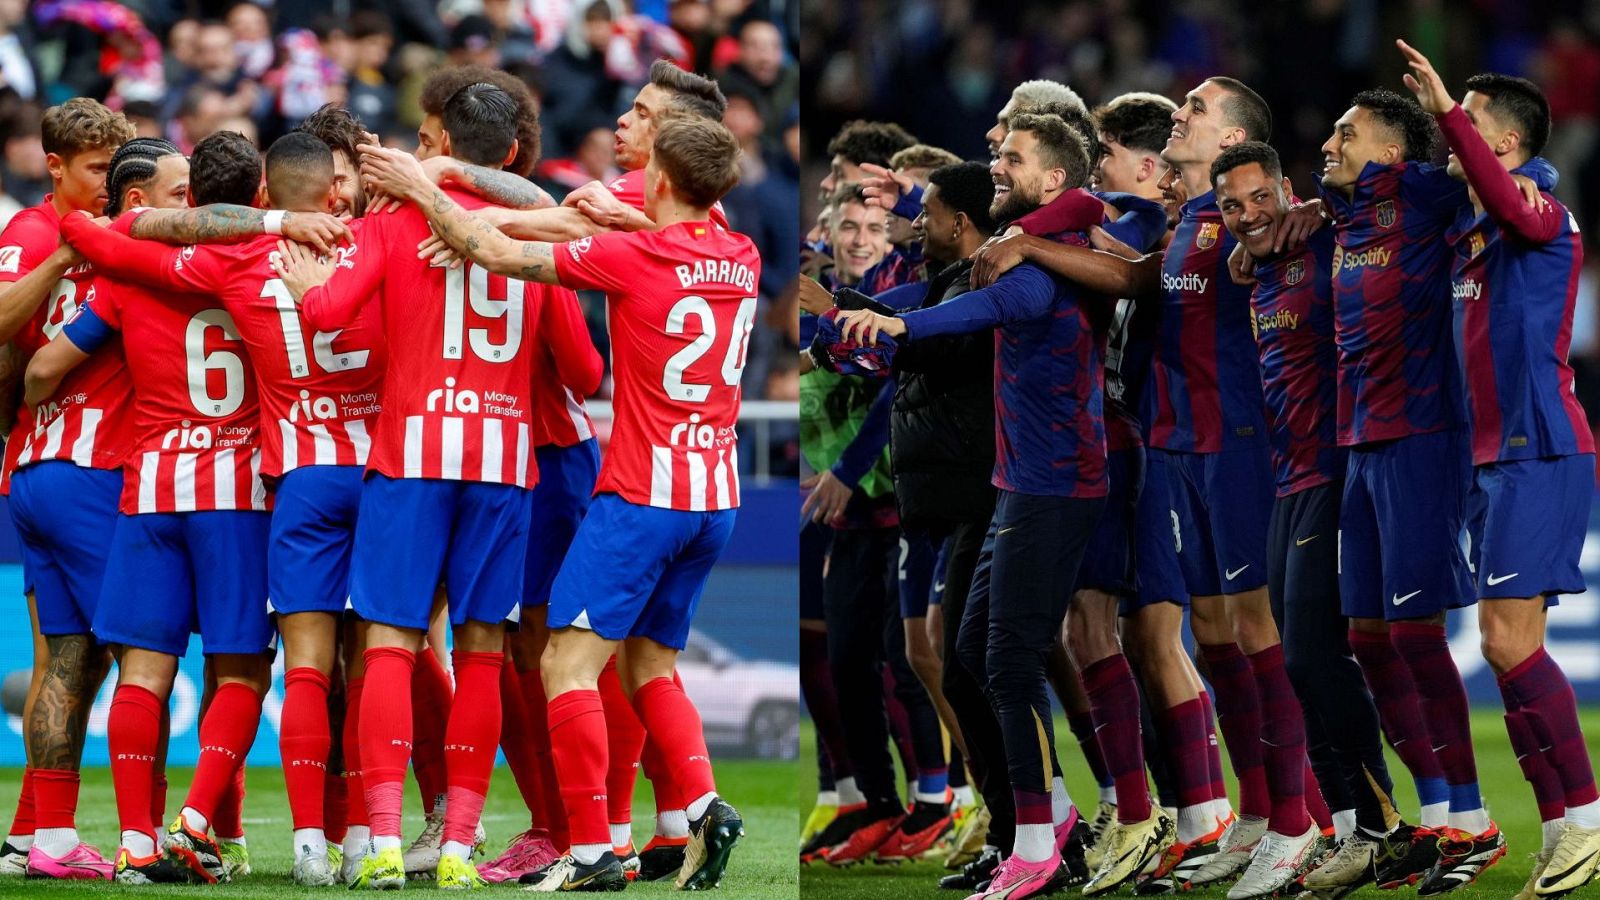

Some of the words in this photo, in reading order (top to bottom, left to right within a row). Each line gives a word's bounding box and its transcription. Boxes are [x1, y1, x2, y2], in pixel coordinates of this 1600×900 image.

[1344, 247, 1391, 270] Spotify
[675, 259, 755, 293] BARRIOS
[1163, 273, 1208, 293] Spotify
[1452, 279, 1482, 300] Spotify
[430, 260, 524, 363] 19
[1258, 310, 1298, 332] Spotify
[662, 295, 757, 402] 24
[185, 308, 244, 418] 6
[289, 389, 338, 423] ria
[340, 392, 377, 404] Money
[427, 376, 479, 413] ria
[484, 390, 517, 406] Money
[341, 403, 382, 417] Transfe
[483, 403, 523, 417] Transfer
[161, 419, 212, 449] ria
[670, 412, 715, 449] ria
[117, 753, 156, 762] ATLET
